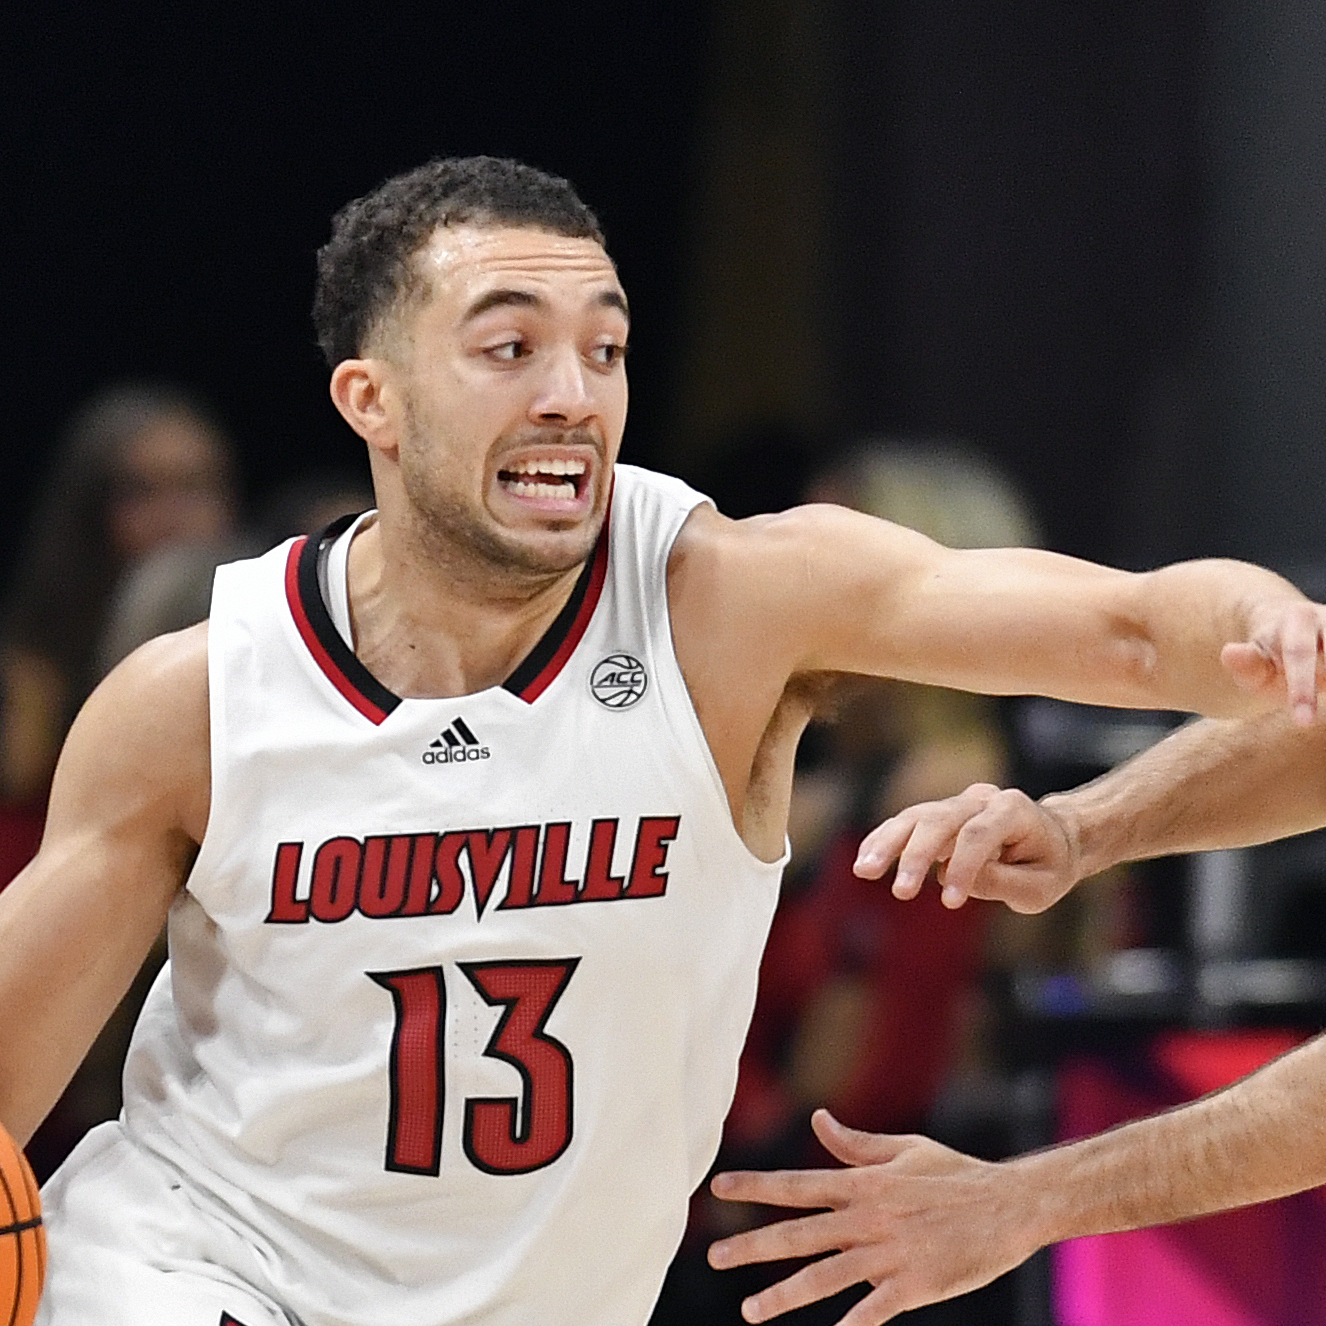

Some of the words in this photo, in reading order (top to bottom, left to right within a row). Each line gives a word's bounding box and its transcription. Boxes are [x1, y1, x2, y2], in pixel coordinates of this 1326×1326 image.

[595, 671, 644, 687] ACC
[421, 745, 491, 765] adidas
[264, 815, 681, 924] LOUISVILLE
[364, 956, 582, 1178] 13
